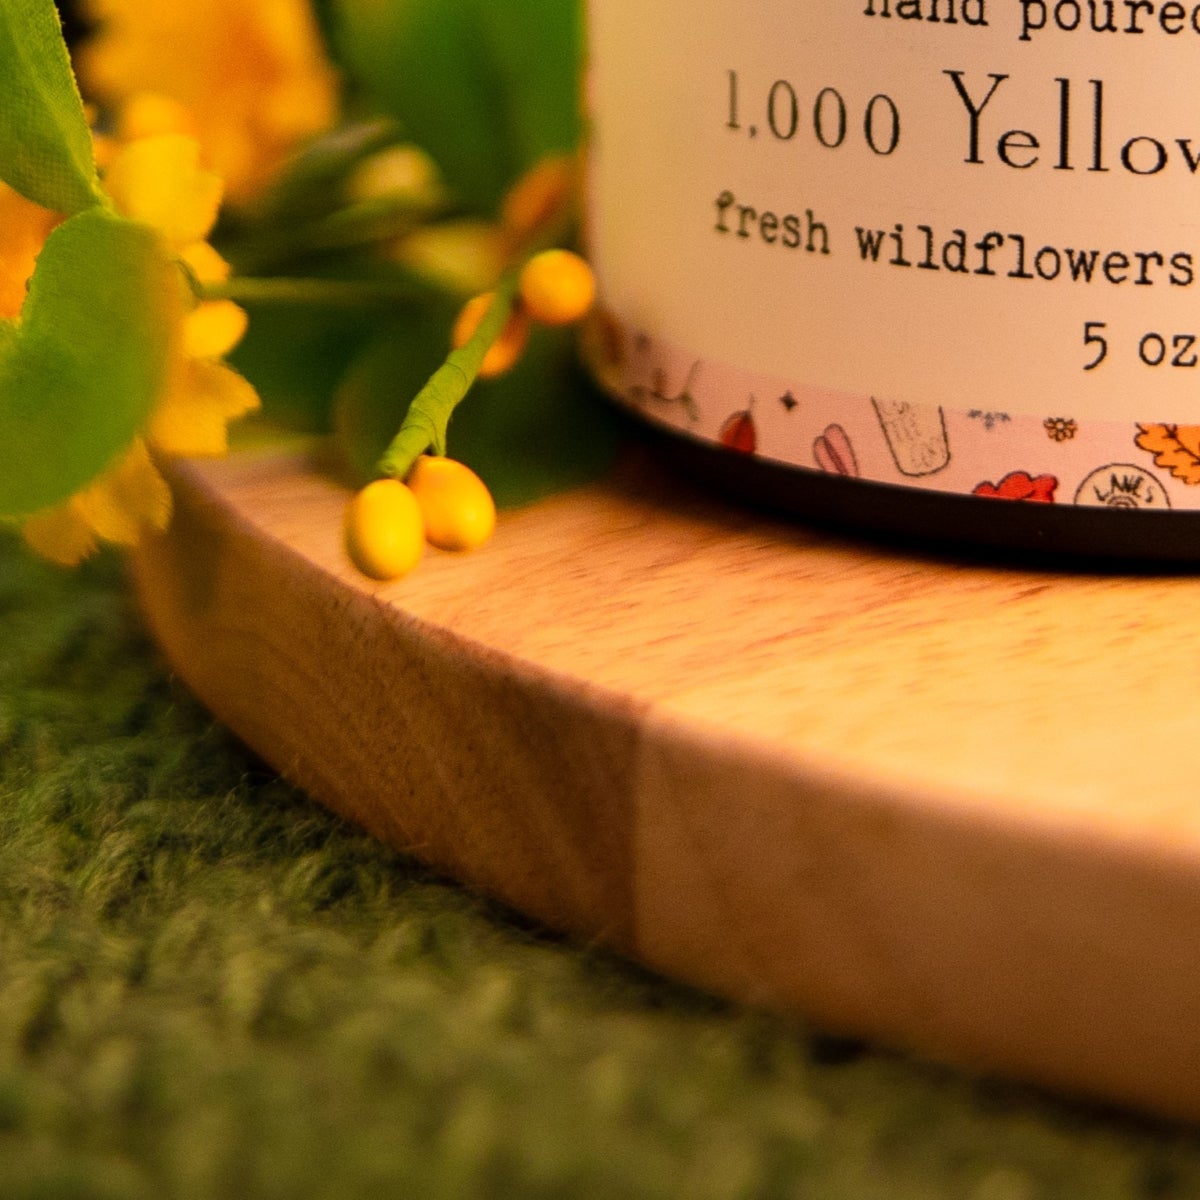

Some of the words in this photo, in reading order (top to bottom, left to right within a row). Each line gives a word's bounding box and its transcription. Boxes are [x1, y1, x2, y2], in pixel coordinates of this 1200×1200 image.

[725, 69, 901, 156] 1,000
[713, 189, 831, 255] fresh
[854, 223, 1195, 288] wildflowers
[1082, 321, 1109, 371] 5
[1138, 331, 1199, 368] oz
